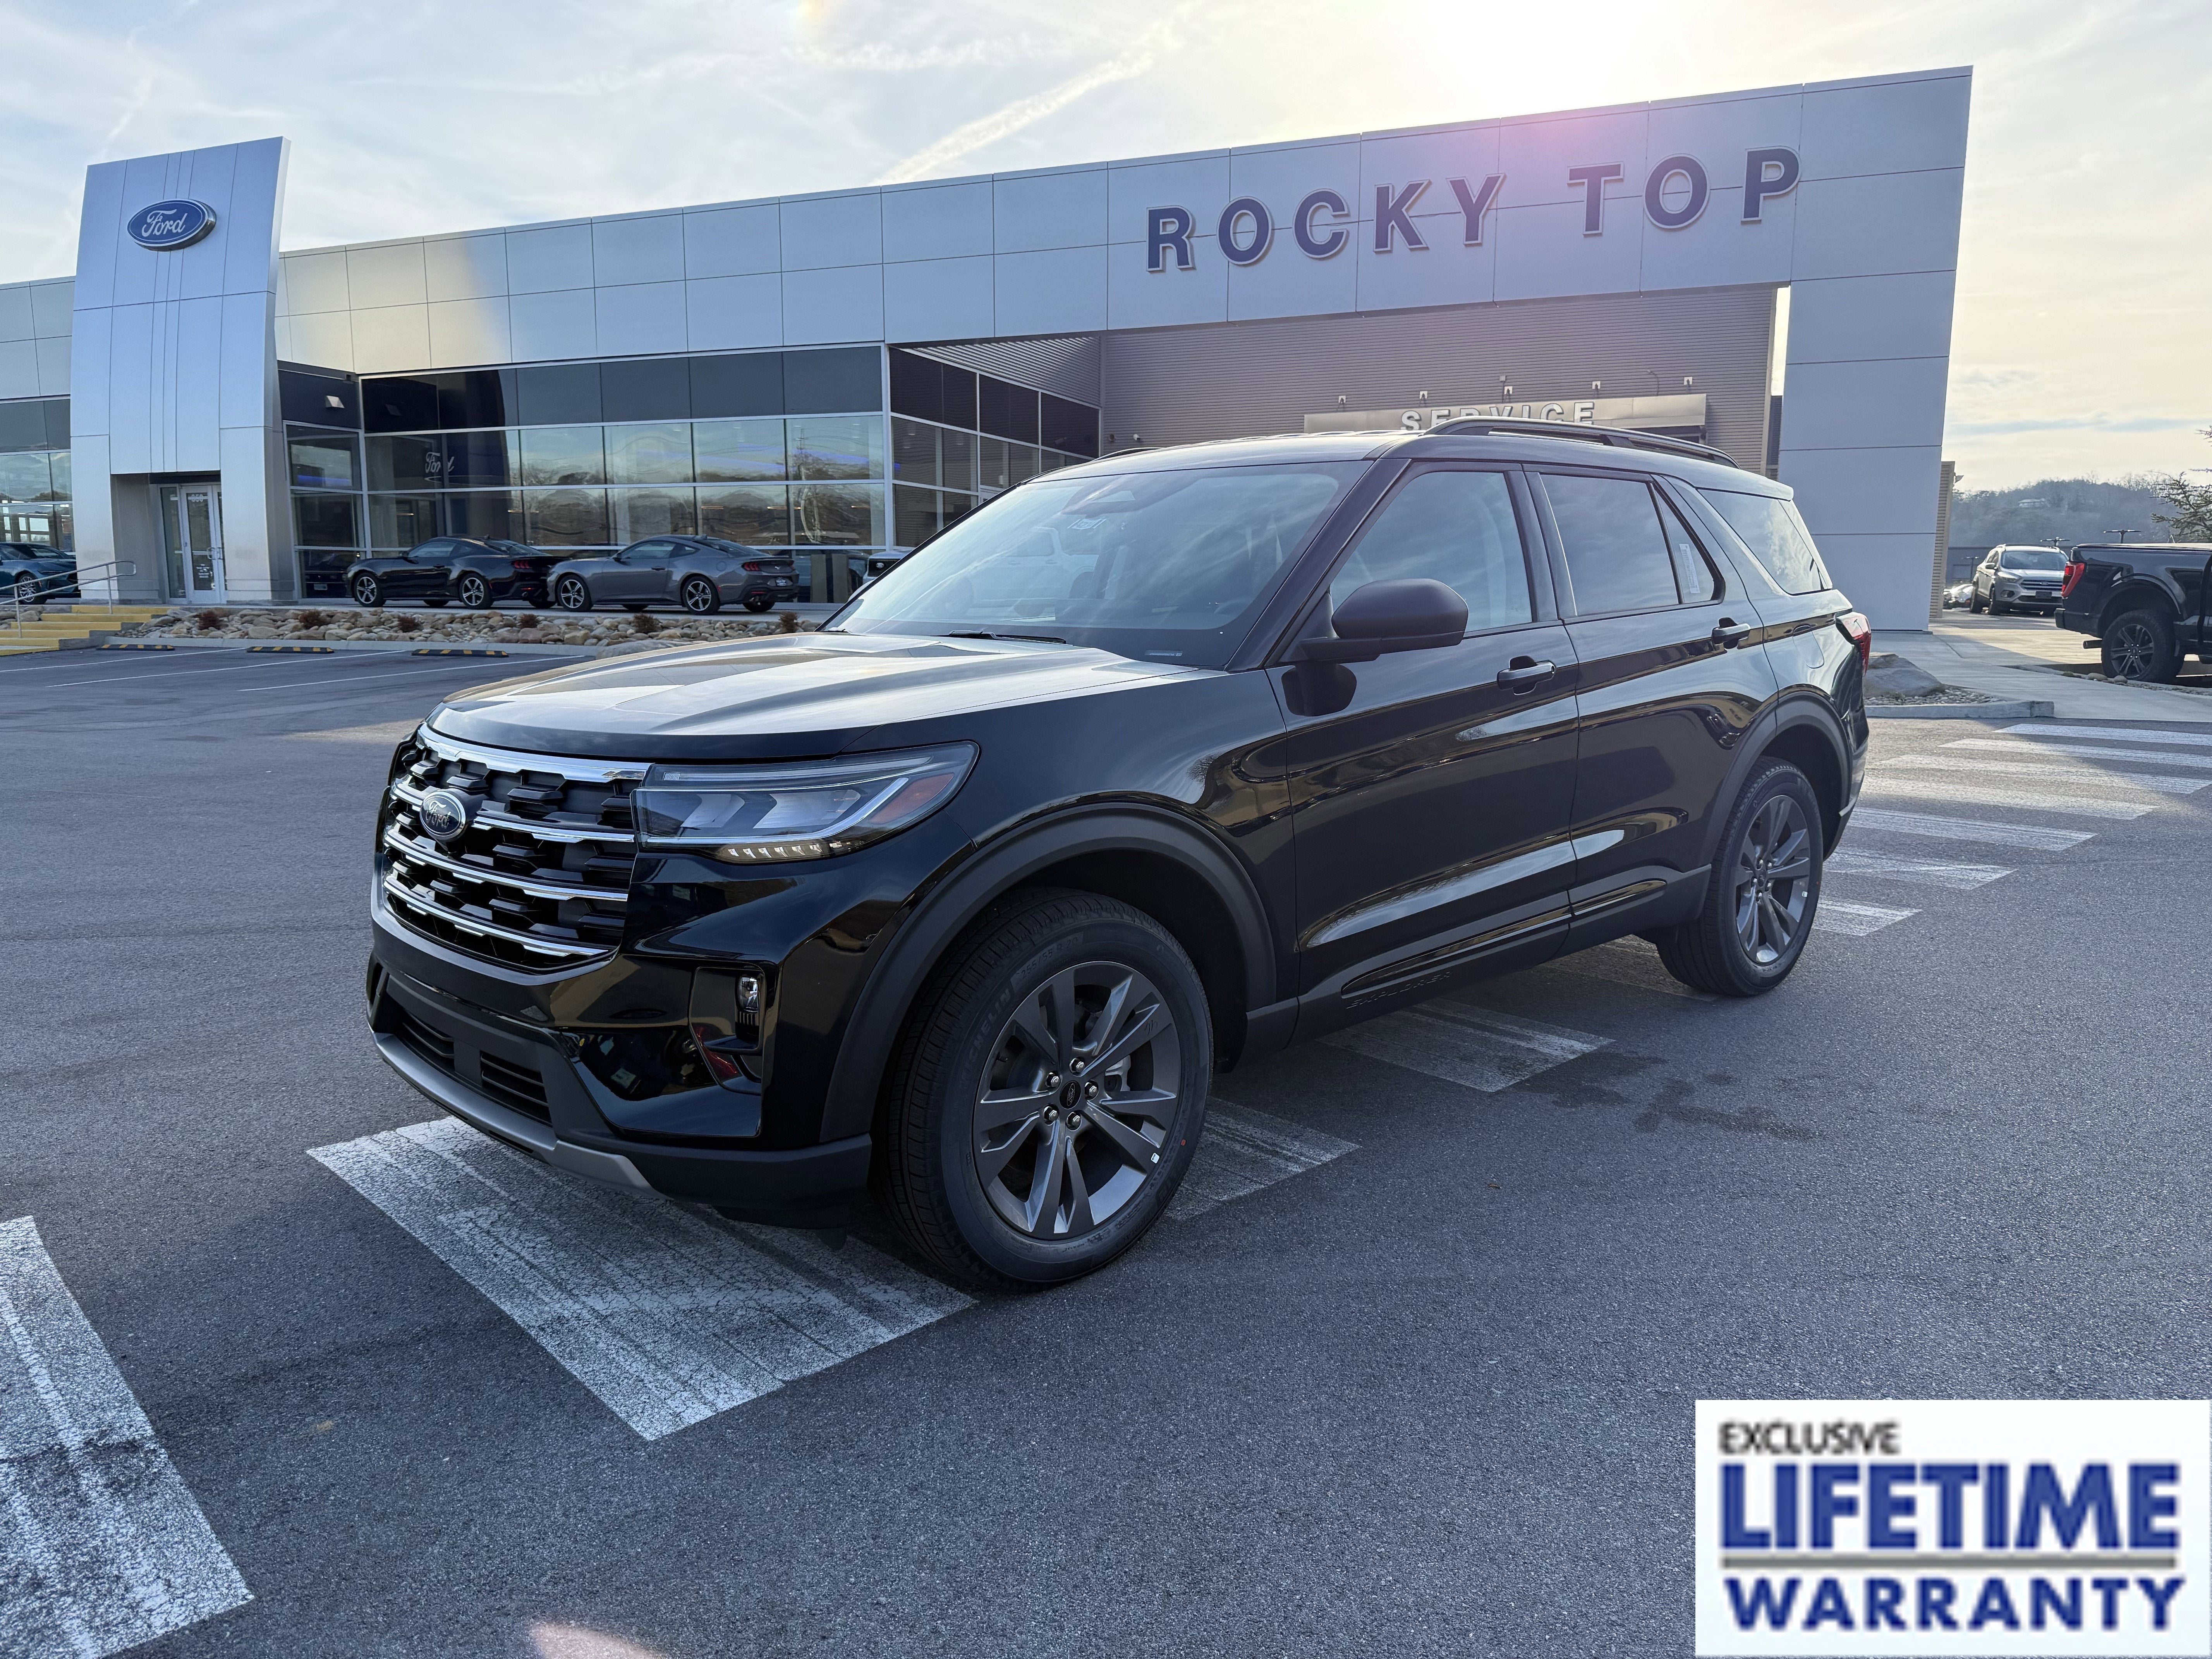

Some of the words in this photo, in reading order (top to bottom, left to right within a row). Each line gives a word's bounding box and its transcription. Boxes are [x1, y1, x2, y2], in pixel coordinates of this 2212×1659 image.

[141, 209, 188, 237] Ford
[1146, 173, 1506, 273] ROCKY
[1567, 145, 1803, 235] TOP
[426, 800, 452, 829] Ford
[1346, 972, 1451, 1009] EXPLORER
